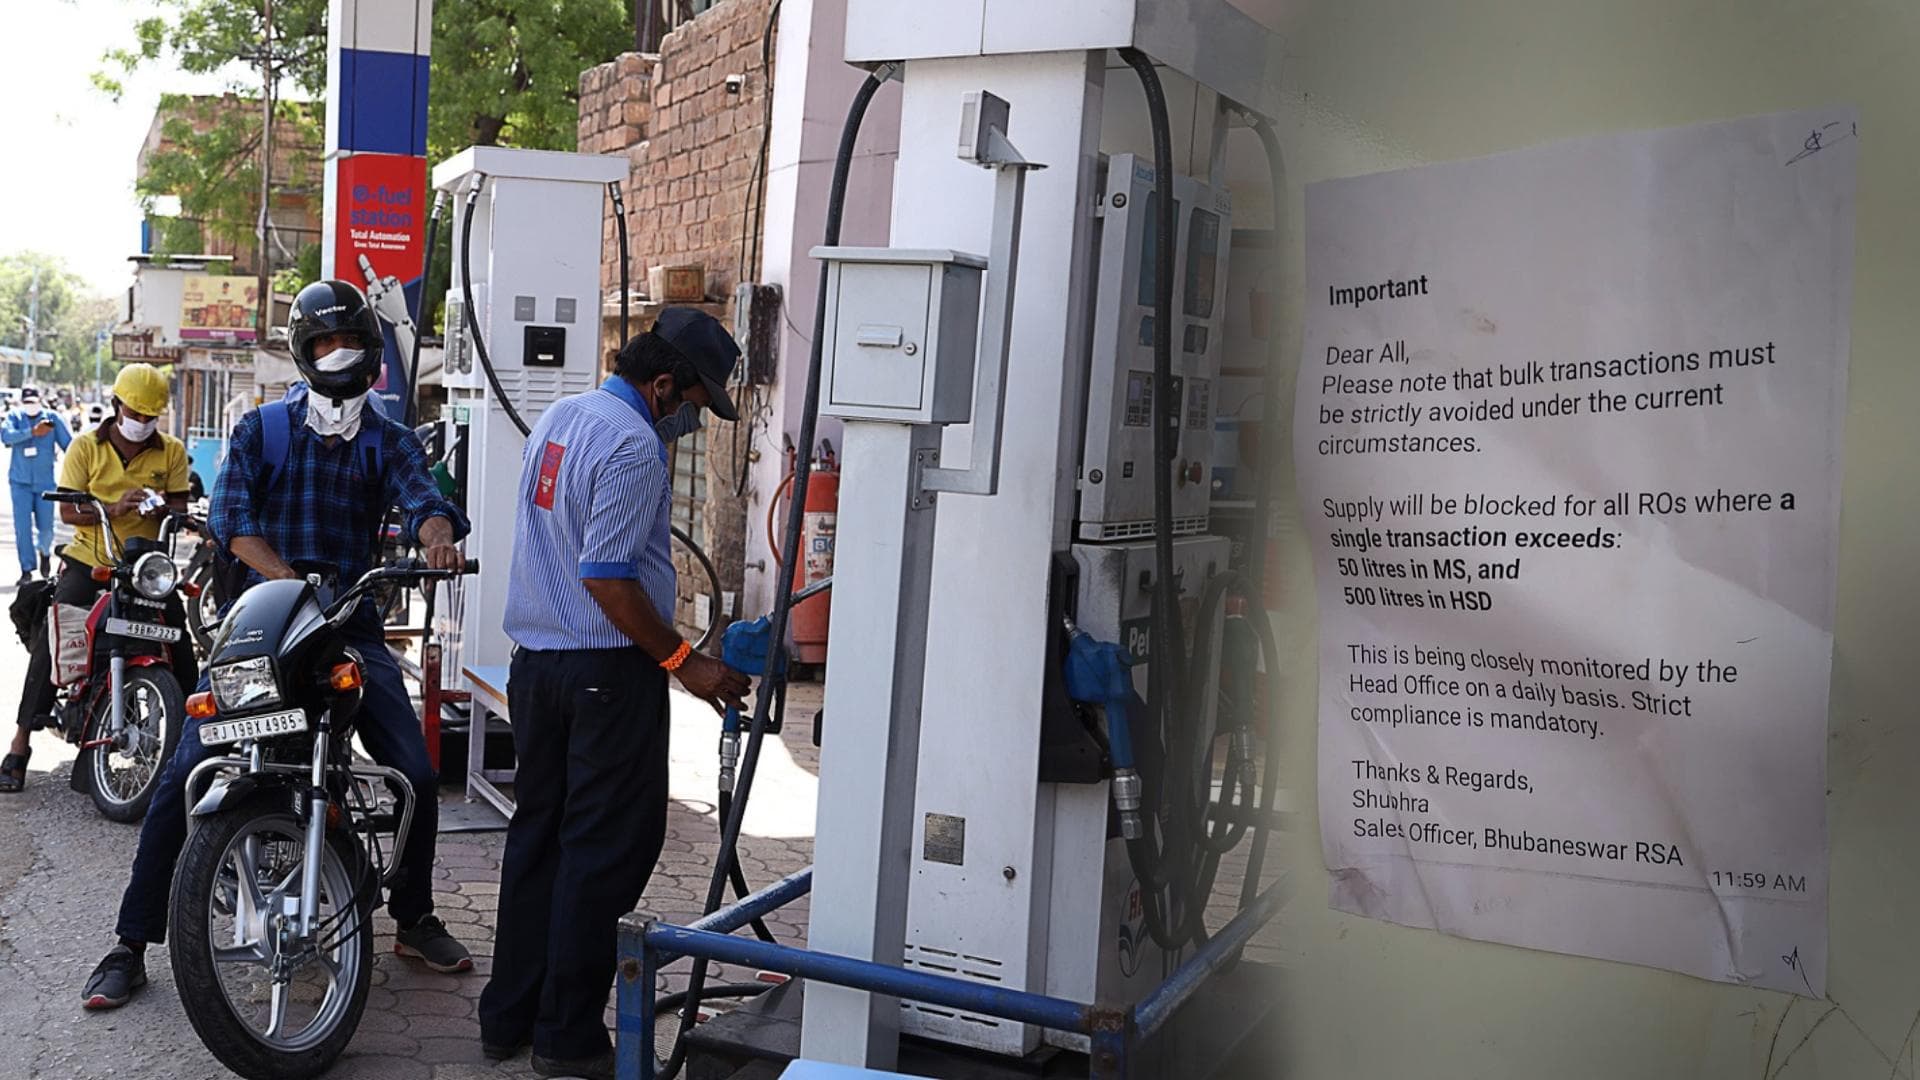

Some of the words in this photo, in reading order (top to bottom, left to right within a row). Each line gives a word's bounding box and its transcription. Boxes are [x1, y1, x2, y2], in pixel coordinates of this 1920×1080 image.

[350, 209, 412, 226] station
[369, 230, 411, 242] Automation
[1329, 274, 1429, 309] Important
[1322, 373, 1394, 395] Please
[1399, 372, 1447, 394] note
[1452, 367, 1494, 392] that
[1499, 360, 1545, 387] bulk
[1549, 350, 1700, 381] transactions
[1708, 341, 1776, 370] must
[1325, 346, 1375, 366] Dear
[1378, 339, 1410, 366] All,
[1319, 403, 1345, 425] be
[1350, 401, 1423, 428] strictly
[1428, 396, 1514, 422] avoided
[1521, 392, 1582, 419] under
[1587, 388, 1628, 414] the
[1634, 383, 1724, 411] current
[1318, 433, 1482, 456] circumstances.
[1322, 495, 1384, 523] Supply
[1389, 492, 1424, 517] will
[1430, 492, 1457, 515] be
[1463, 492, 1556, 517] blocked
[1563, 493, 1597, 517] for
[1603, 491, 1629, 517] all
[1638, 491, 1687, 516] ROs
[1694, 488, 1772, 513] where
[1779, 492, 1796, 511] a
[1330, 527, 1383, 553] single
[1385, 524, 1507, 549] transaction
[1514, 526, 1623, 549] exceeds:
[1337, 557, 1359, 577] 50
[1360, 557, 1407, 579] litres
[1409, 558, 1429, 580] in
[1432, 558, 1472, 585] MS,
[1477, 557, 1521, 580] and
[1343, 586, 1377, 606] 500
[1378, 586, 1425, 608] litres
[1426, 588, 1447, 610] in
[1449, 590, 1493, 612] HSD
[1128, 626, 1150, 657] Pet
[1346, 643, 1388, 665] This
[1393, 644, 1409, 665] is
[1414, 644, 1466, 672] being
[1470, 648, 1535, 678] closely
[1540, 656, 1651, 681] monitored
[1659, 658, 1689, 688] by
[1695, 658, 1738, 684] the
[1349, 673, 1398, 694] Head
[1403, 674, 1460, 696] Office
[1465, 681, 1490, 697] on
[1495, 683, 1507, 699] a
[1511, 679, 1556, 708] daily
[1560, 683, 1626, 709] basis.
[1631, 690, 1692, 718] Strict
[212, 725, 228, 741] RJ
[265, 713, 298, 732] 4985
[1350, 703, 1462, 729] compliance
[1466, 706, 1484, 728] is
[1490, 710, 1604, 740] mandatory.
[1351, 759, 1421, 783] Thanks
[1426, 764, 1441, 785] &
[1445, 765, 1534, 795] Regards,
[1408, 822, 1478, 850] Officer,
[1484, 827, 1629, 861] Bhubaneswar
[1635, 841, 1684, 867] RSA
[1711, 870, 1767, 890] 11:59
[1772, 874, 1806, 893] AM
